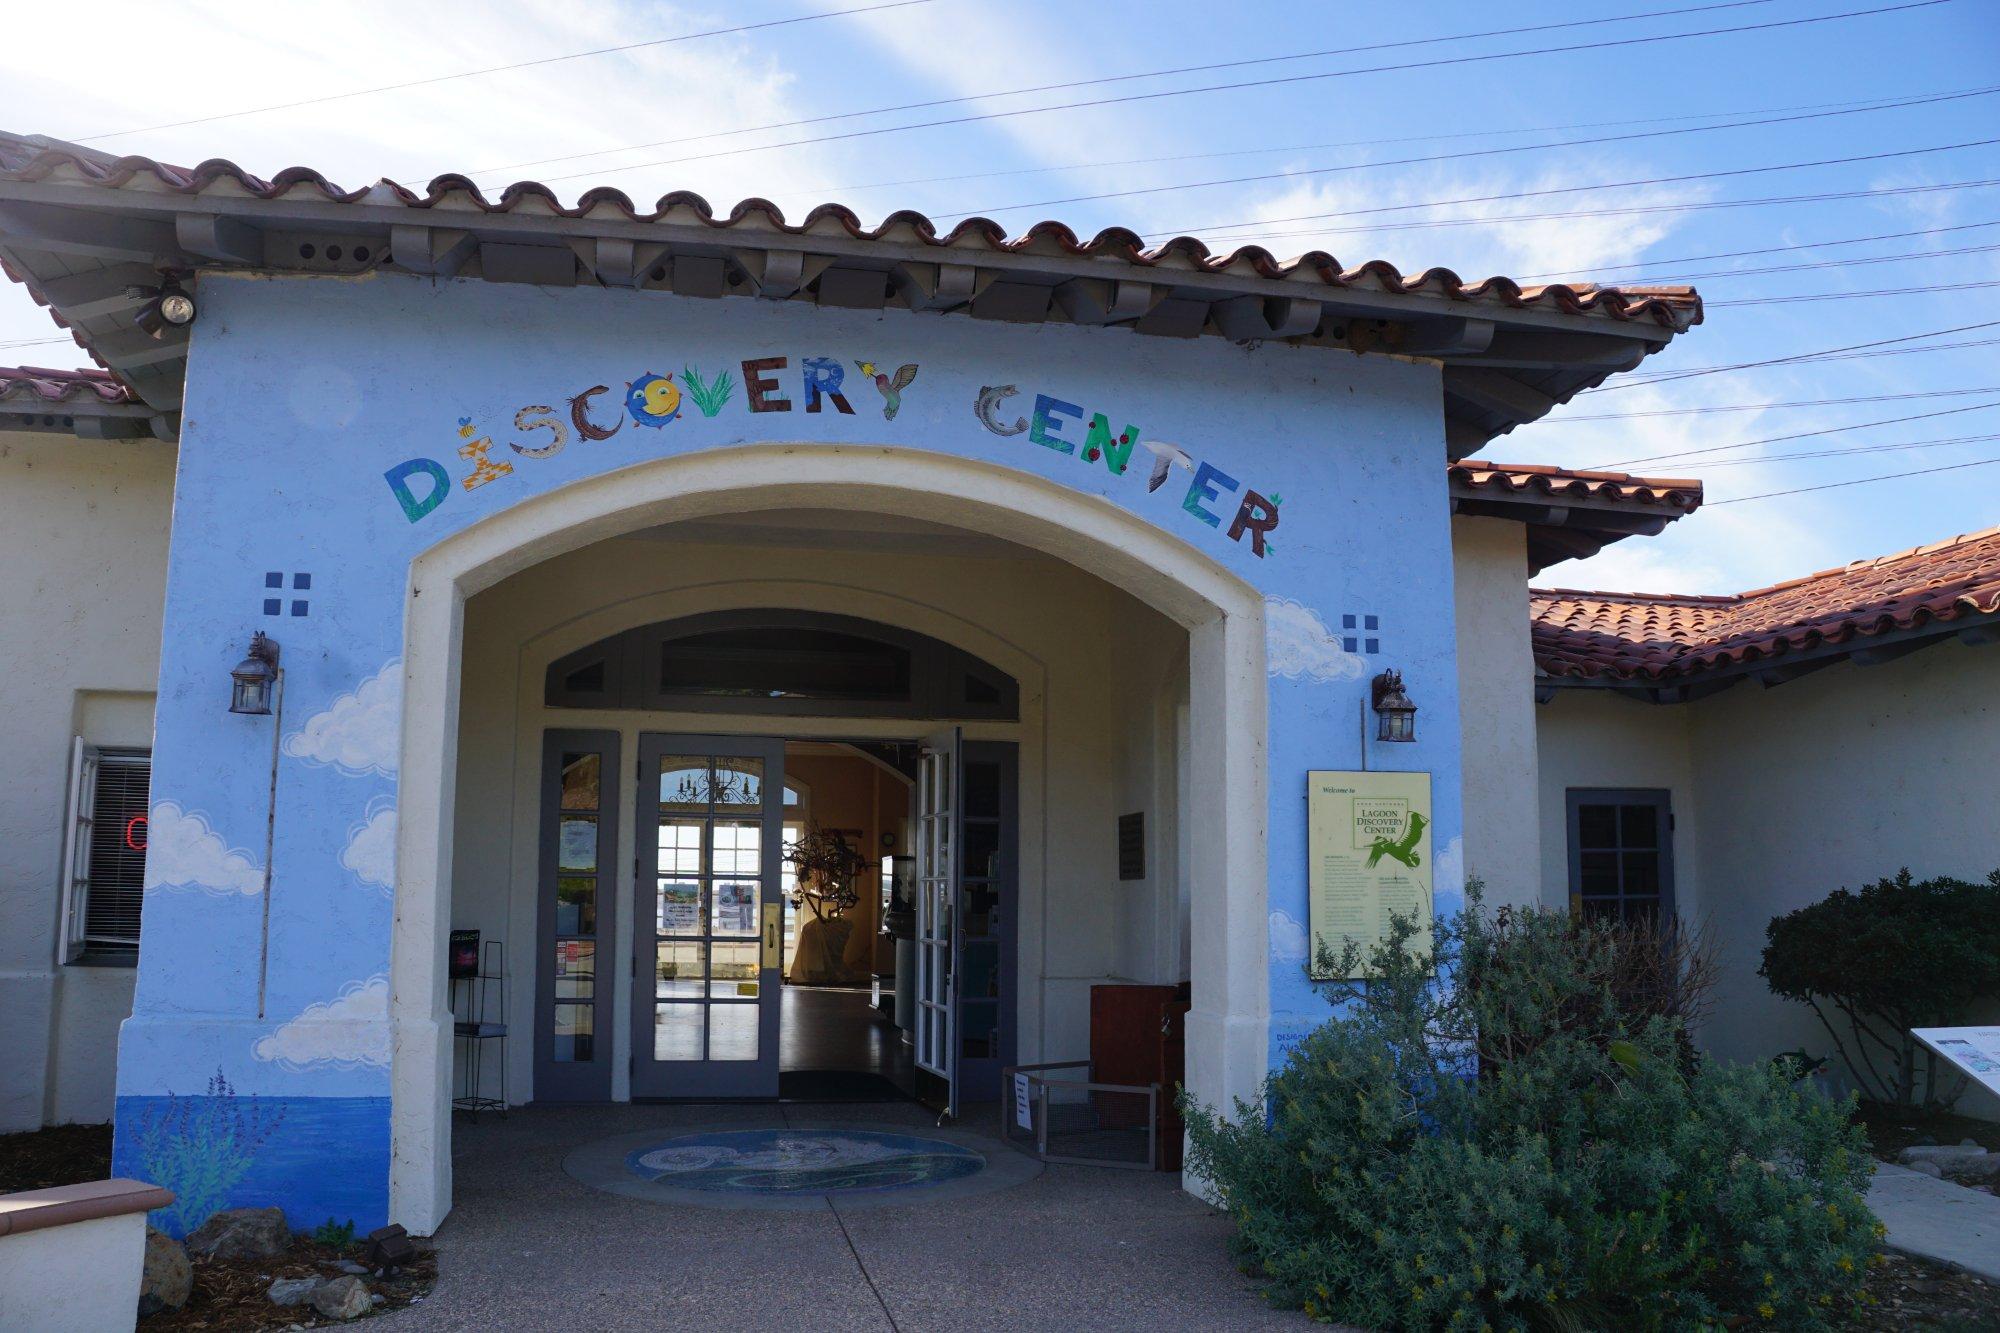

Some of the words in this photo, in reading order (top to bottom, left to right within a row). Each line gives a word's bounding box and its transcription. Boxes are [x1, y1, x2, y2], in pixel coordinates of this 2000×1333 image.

[384, 357, 918, 524] DISCOVERY
[974, 384, 1283, 559] CENTER
[1323, 786, 1348, 794] Welcome
[1362, 809, 1398, 818] LAGOON
[1357, 817, 1403, 826] DISCOVERY
[1364, 826, 1396, 834] CENTER
